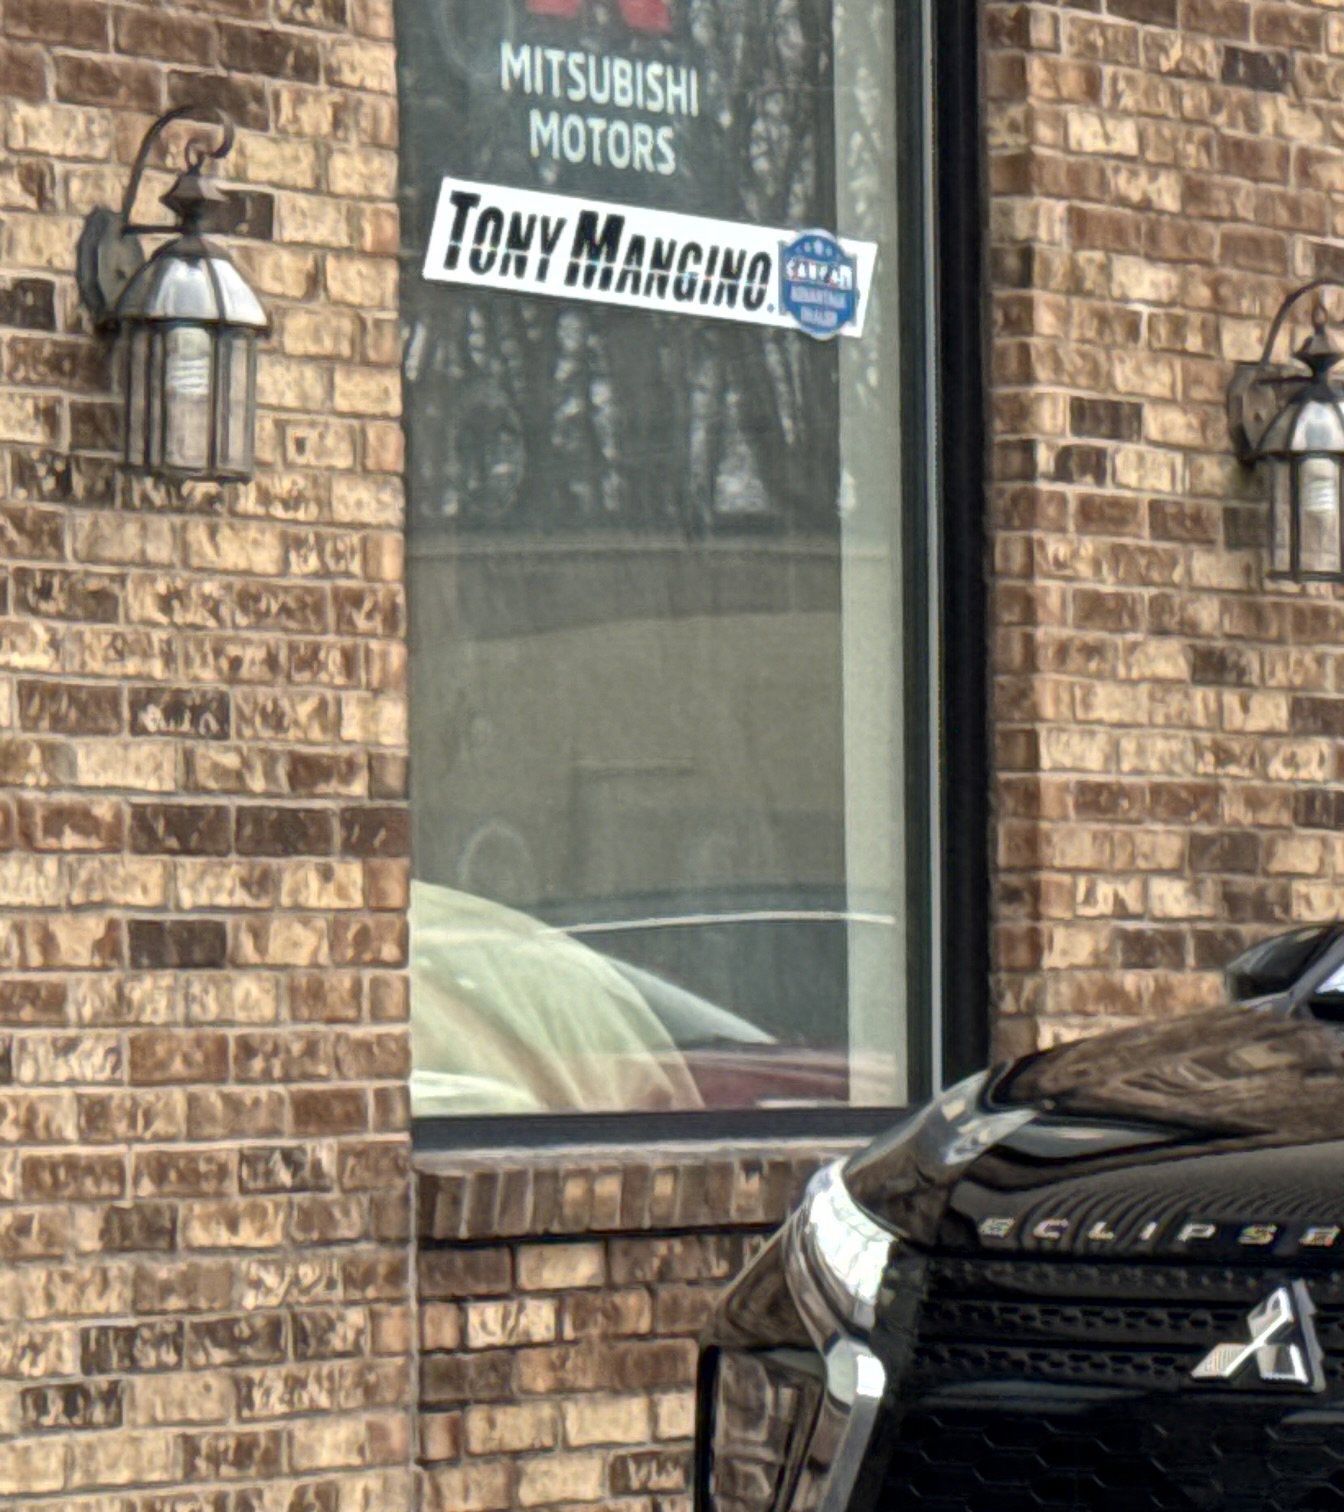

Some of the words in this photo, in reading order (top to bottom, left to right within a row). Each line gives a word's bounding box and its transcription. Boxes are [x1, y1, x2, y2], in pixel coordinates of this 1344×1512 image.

[500, 41, 699, 118] MITSUBISHI
[529, 108, 676, 176] MOTORS
[443, 191, 567, 282] TONY
[978, 1217, 1341, 1246] ECLIPSE
